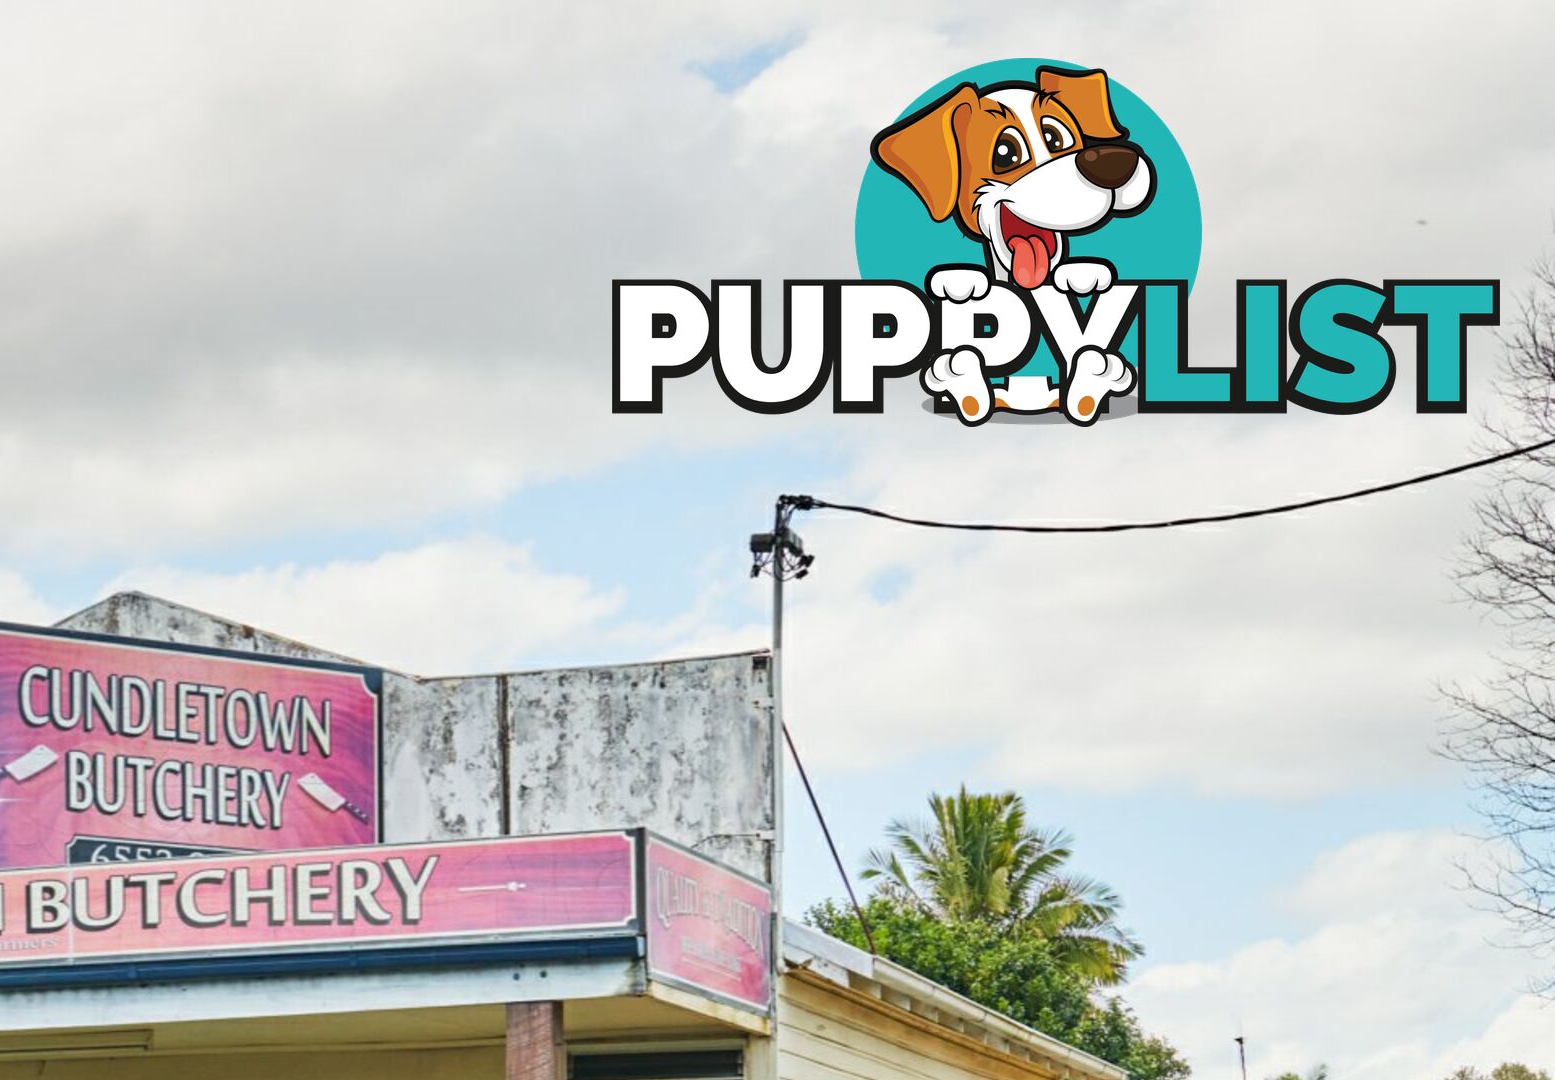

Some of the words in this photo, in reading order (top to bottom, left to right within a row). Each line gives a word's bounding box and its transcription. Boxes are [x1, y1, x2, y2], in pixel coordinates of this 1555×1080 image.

[18, 665, 332, 757] CUNDLETOWN
[66, 750, 291, 830] BUTCHERY
[26, 855, 440, 934] BUTCHERY
